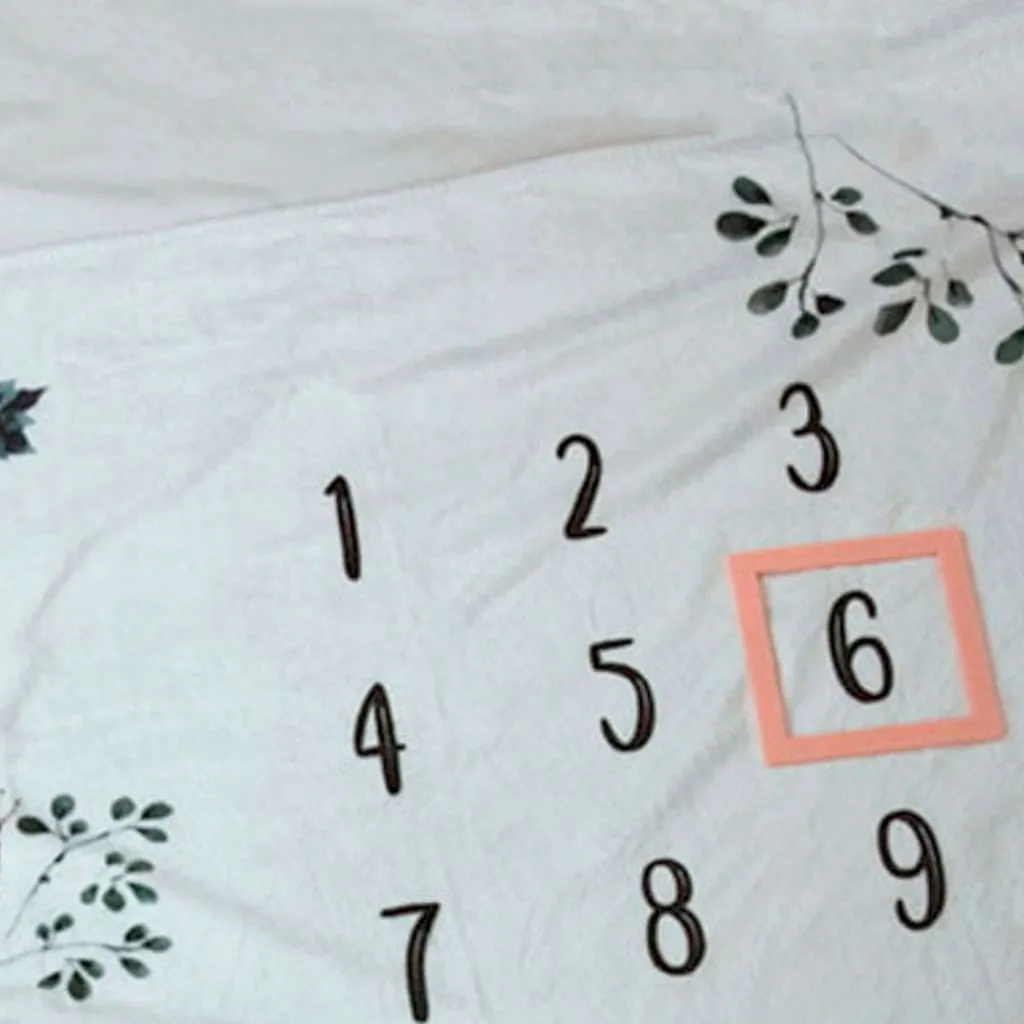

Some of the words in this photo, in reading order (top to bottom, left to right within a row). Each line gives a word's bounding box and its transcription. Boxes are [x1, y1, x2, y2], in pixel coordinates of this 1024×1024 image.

[324, 475, 361, 581] 1
[556, 434, 607, 540] 2
[779, 382, 840, 493] 3
[353, 683, 406, 796] 4
[589, 638, 656, 753] 5
[827, 590, 894, 704] 6
[380, 902, 440, 1023] 7
[641, 858, 706, 976] 8
[877, 809, 947, 931] 9
